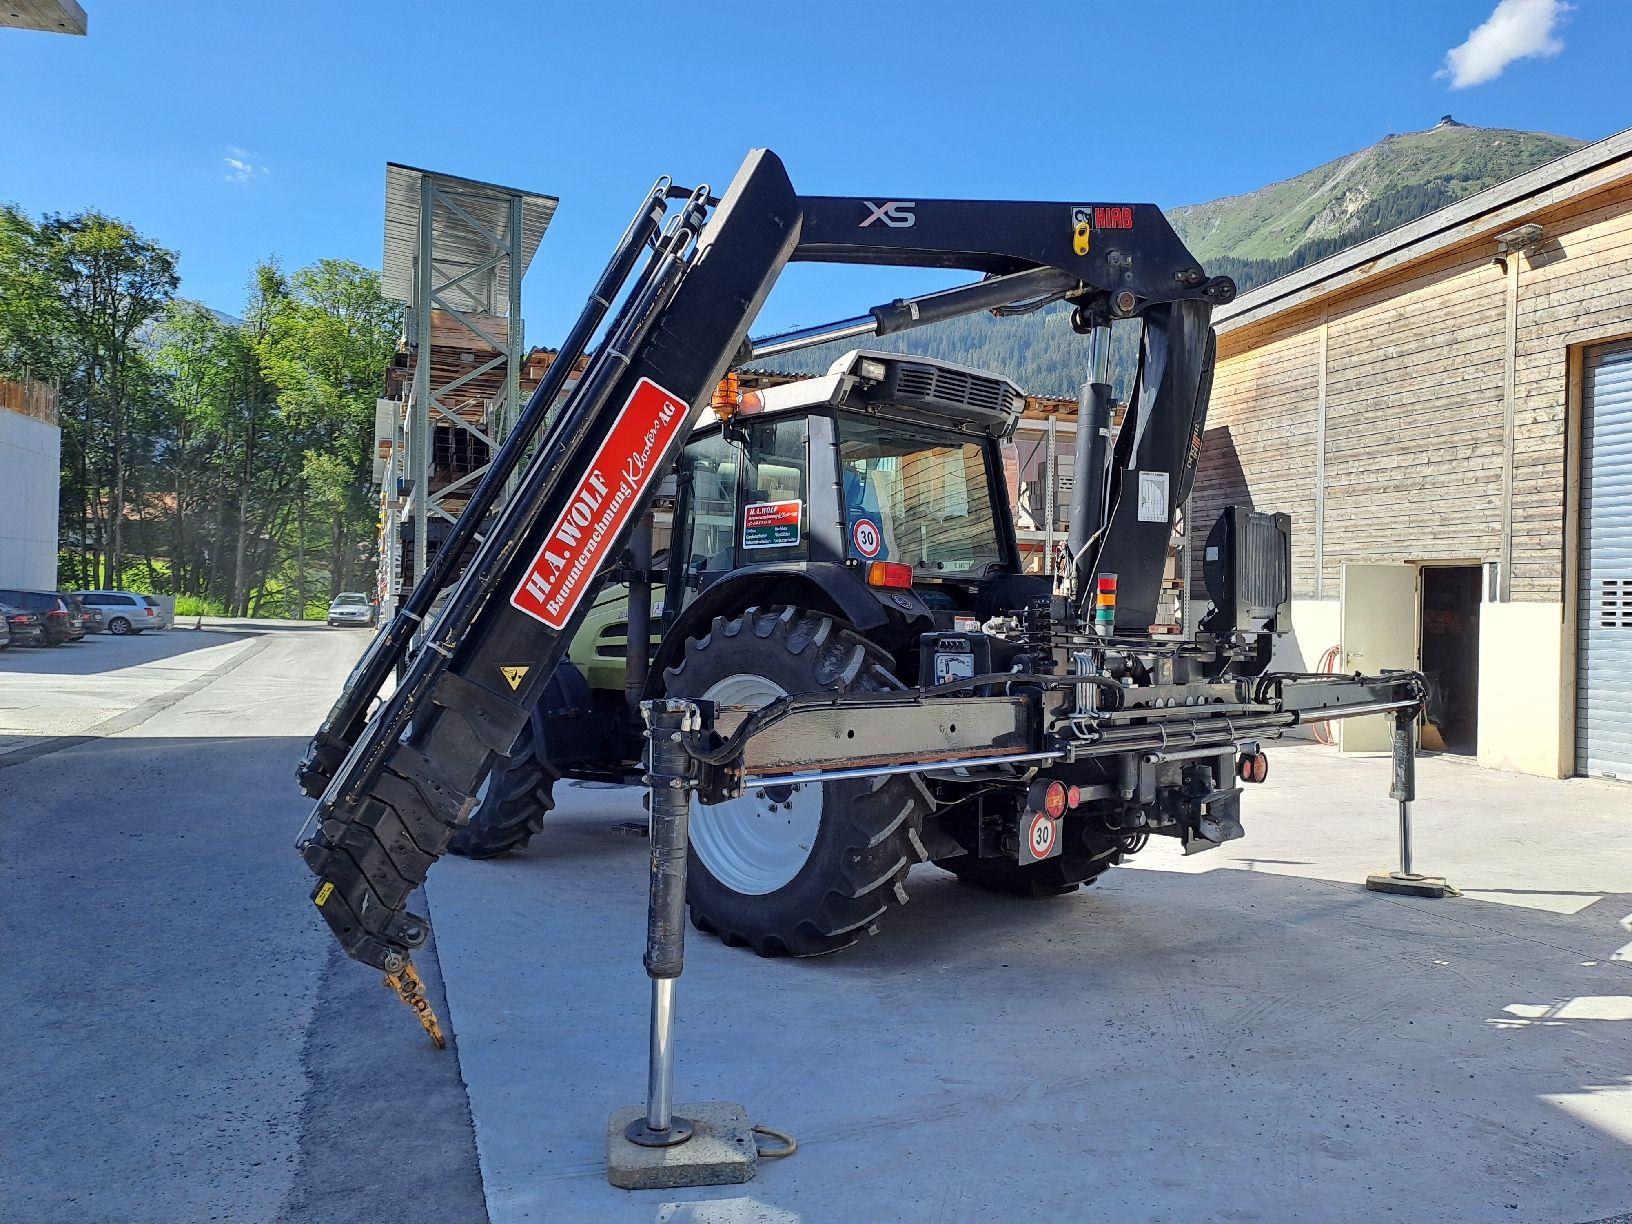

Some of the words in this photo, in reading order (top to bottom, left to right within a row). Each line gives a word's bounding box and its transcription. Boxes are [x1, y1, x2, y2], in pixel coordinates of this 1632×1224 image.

[858, 201, 916, 228] XS
[1094, 207, 1133, 229] HIAB
[545, 480, 632, 617] Bauunternehmung
[621, 420, 661, 490] Klosters
[657, 400, 676, 427] AG
[525, 548, 571, 605] H.A.
[556, 469, 610, 547] WOLF
[861, 530, 874, 546] 30
[1036, 825, 1049, 846] 30
